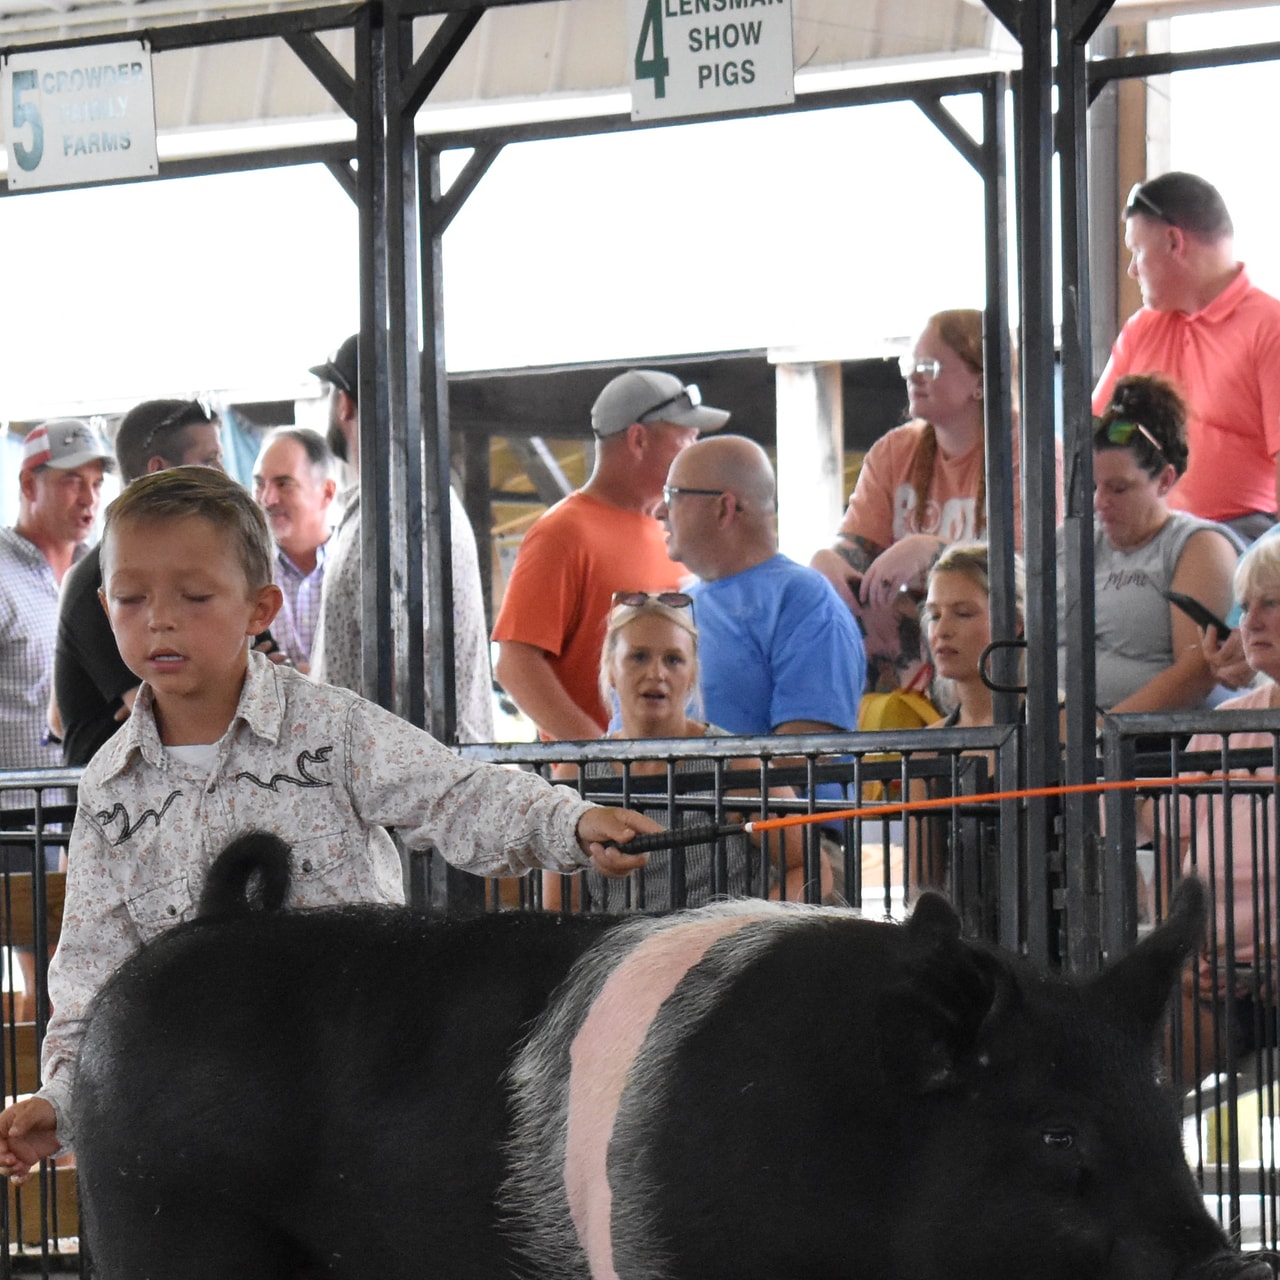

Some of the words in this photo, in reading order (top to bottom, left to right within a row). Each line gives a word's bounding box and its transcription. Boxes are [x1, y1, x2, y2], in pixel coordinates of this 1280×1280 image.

[634, 0, 669, 99] 4
[688, 20, 762, 52] SHOW
[42, 62, 144, 94] CROWDER
[698, 59, 755, 89] PIGS
[12, 69, 44, 172] 5
[63, 130, 131, 156] FARMS
